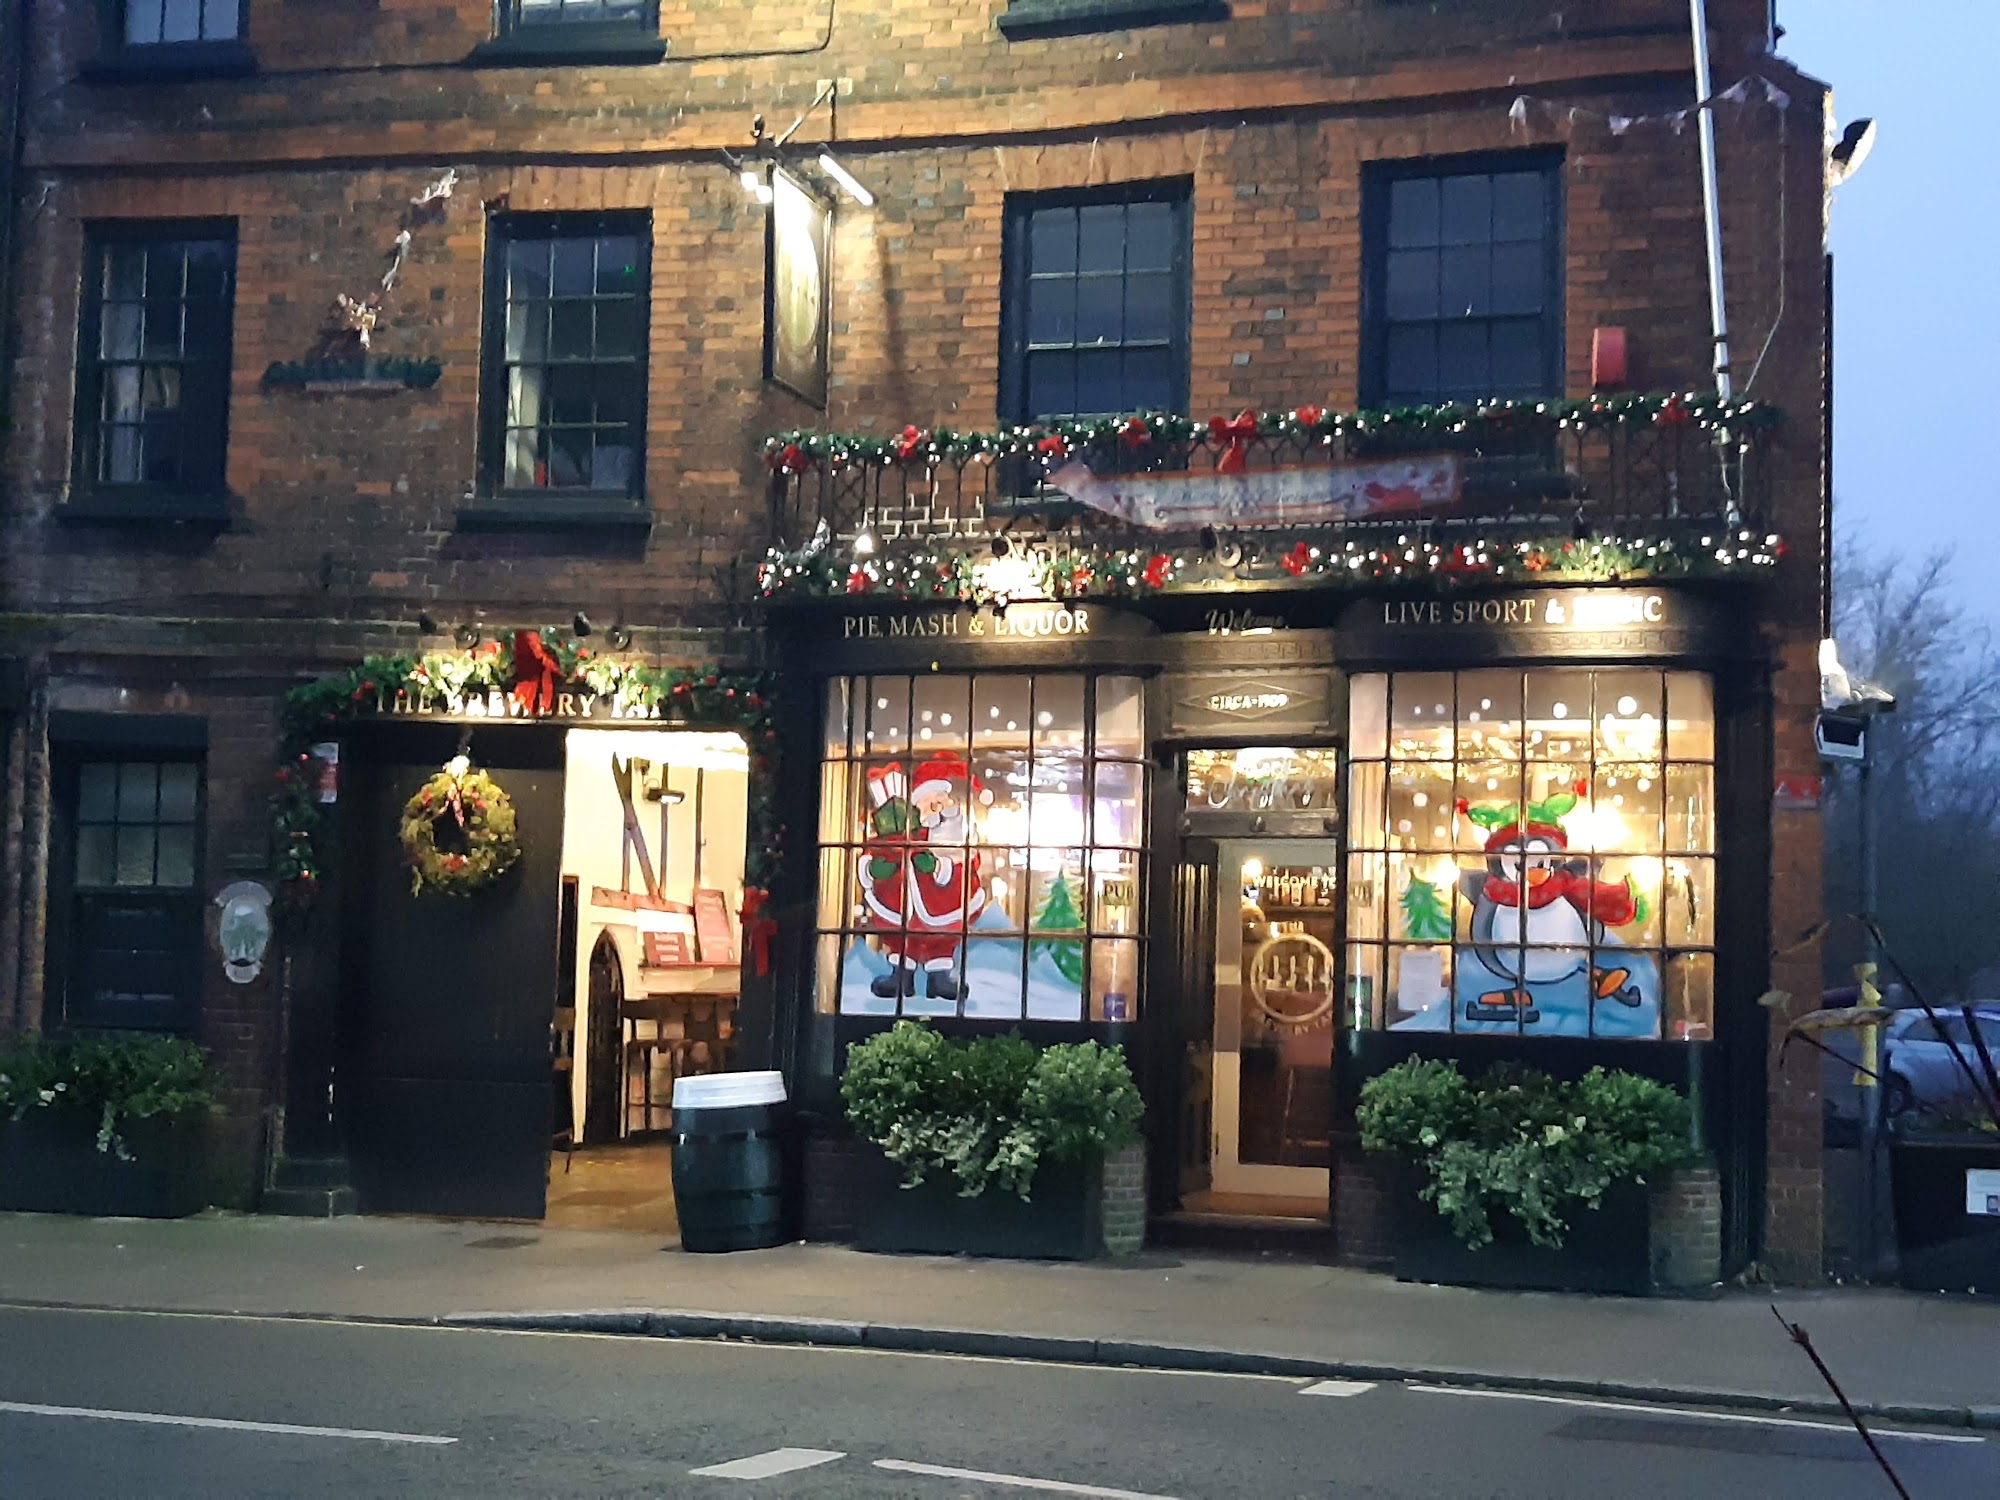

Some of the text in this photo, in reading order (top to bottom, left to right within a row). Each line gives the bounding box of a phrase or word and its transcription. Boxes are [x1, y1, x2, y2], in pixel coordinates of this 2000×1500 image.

[1384, 601, 1442, 625] LIVE
[1452, 599, 1536, 625] SPORT
[1545, 598, 1566, 624] &
[889, 613, 958, 637] MASH
[968, 615, 985, 636] &
[994, 609, 1090, 637] LIQUOR
[1104, 883, 1134, 898] PUB
[1252, 875, 1318, 889] WELCOME
